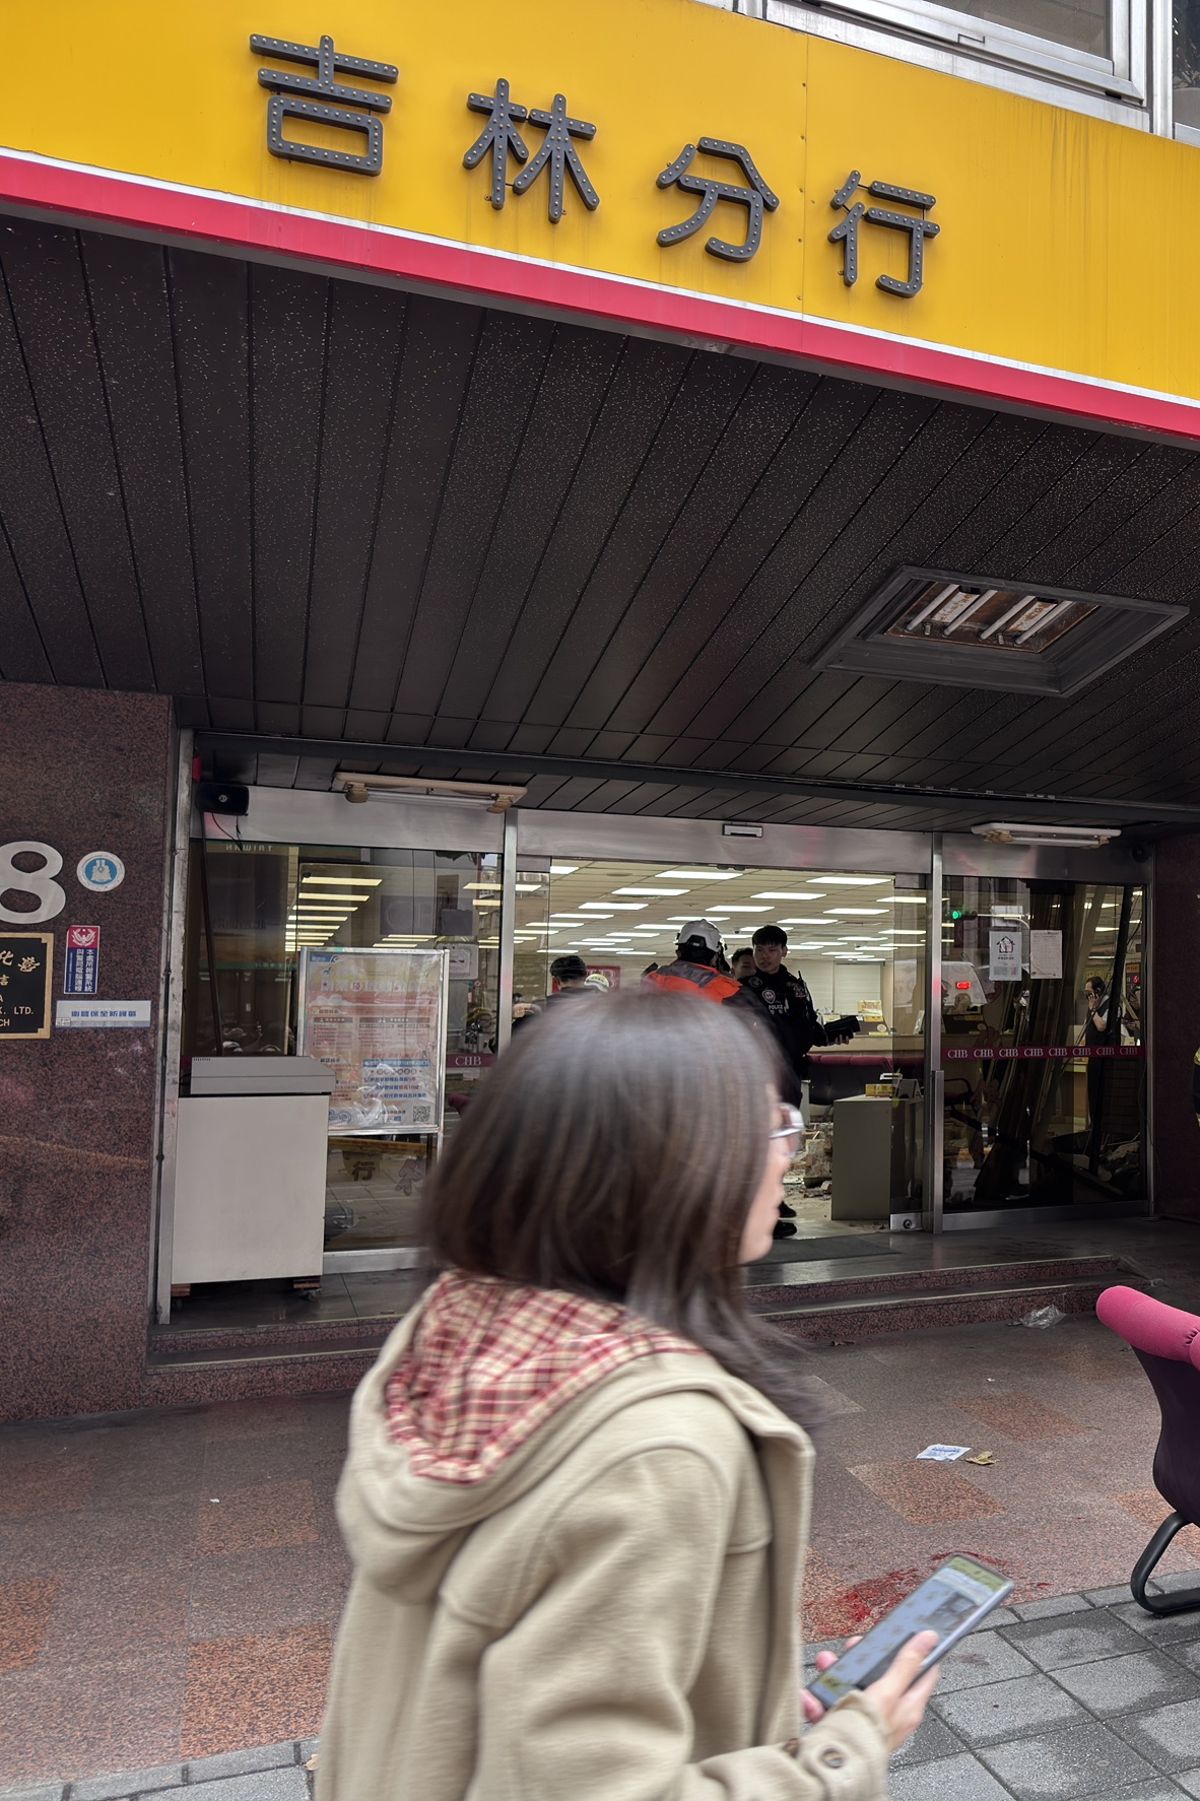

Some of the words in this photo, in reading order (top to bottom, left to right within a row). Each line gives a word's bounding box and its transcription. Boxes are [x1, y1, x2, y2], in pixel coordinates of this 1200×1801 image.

[250, 34, 941, 298] 吉林分行
[0, 841, 66, 924] 8
[14, 1006, 34, 1015] LTD.
[947, 1049, 968, 1059] CHB
[973, 1048, 994, 1058] CHB
[999, 1048, 1019, 1058] CHB
[1024, 1047, 1044, 1057] CHB
[1048, 1047, 1068, 1057] CHB
[1073, 1047, 1091, 1057] CHB
[1096, 1047, 1115, 1056] CHB
[455, 1055, 481, 1066] CHB
